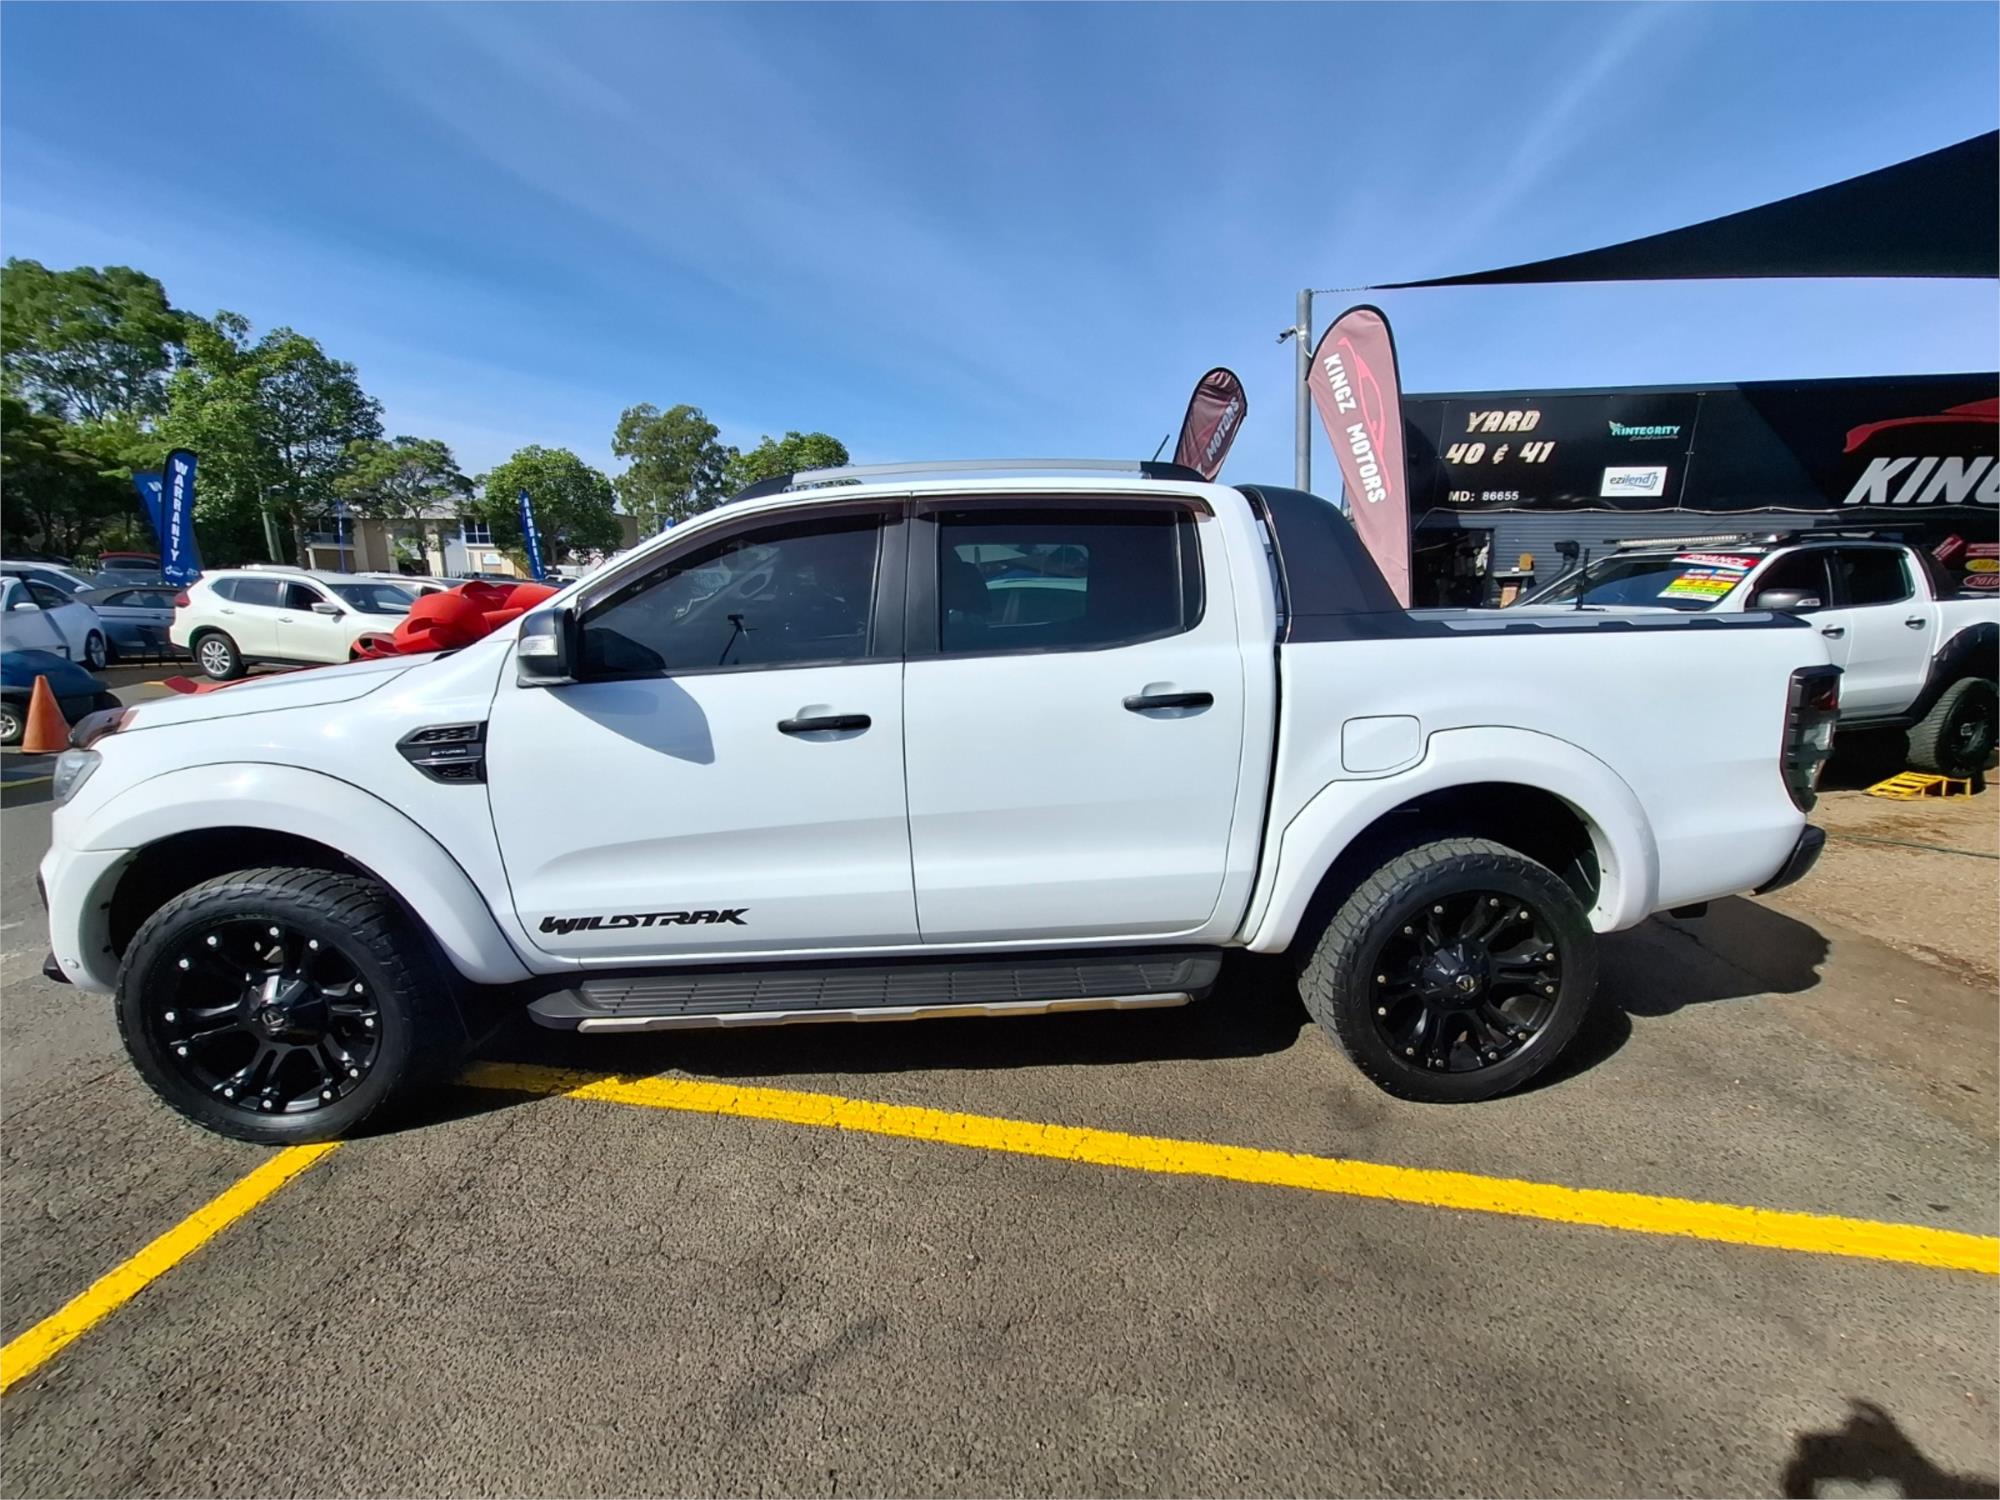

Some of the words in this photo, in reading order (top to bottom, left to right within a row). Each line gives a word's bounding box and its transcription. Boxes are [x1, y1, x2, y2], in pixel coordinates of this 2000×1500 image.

[1206, 396, 1240, 462] MOTORS
[1324, 353, 1358, 414] KINGZ
[1346, 422, 1387, 504] MOTORS
[1466, 410, 1541, 433] YARD
[1621, 426, 1680, 436] INTEGRITY
[1445, 442, 1486, 464] 40
[1493, 443, 1509, 464] &
[1519, 441, 1556, 463] 41
[1448, 491, 1475, 502] MD:
[1482, 491, 1519, 501] 86655
[171, 459, 189, 562] WARRANTY
[539, 908, 750, 935] WILDTRAK
